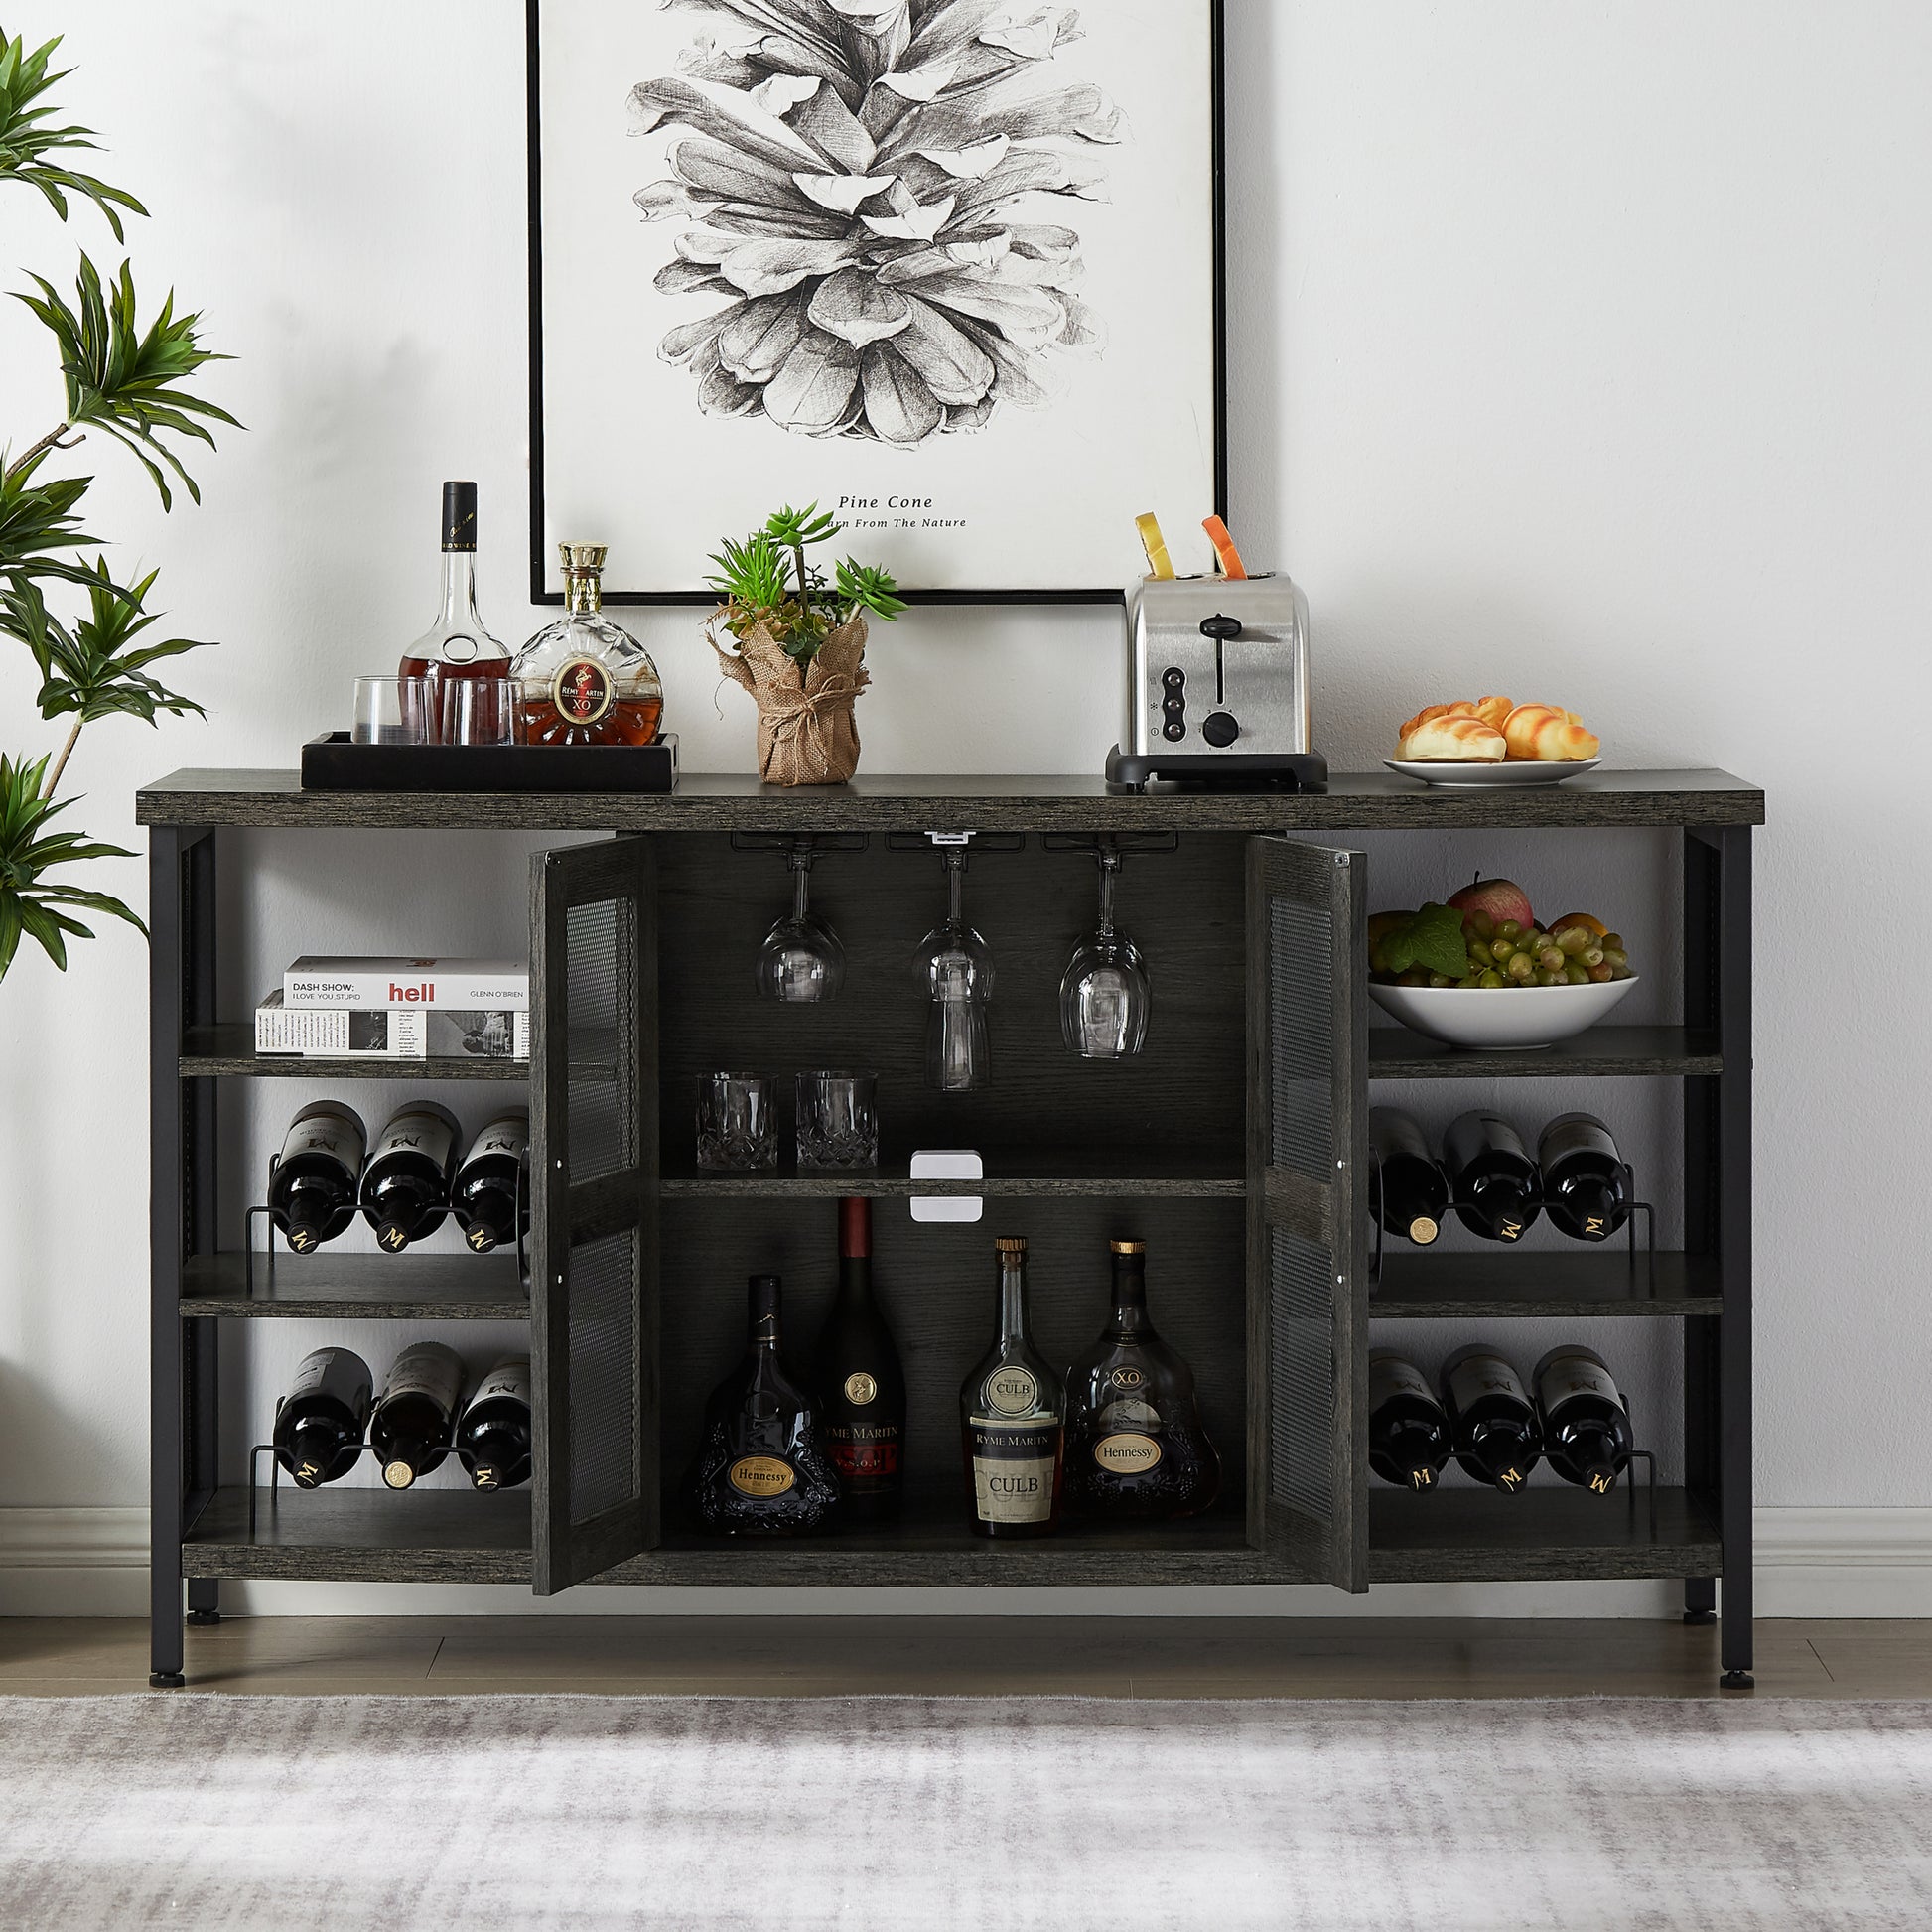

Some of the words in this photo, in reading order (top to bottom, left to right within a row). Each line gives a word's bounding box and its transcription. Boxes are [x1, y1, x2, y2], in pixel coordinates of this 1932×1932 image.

[838, 495, 879, 509] Pine
[887, 495, 933, 509] Cone
[855, 518, 888, 528] From
[894, 518, 916, 528] The
[921, 518, 966, 528] Nature
[572, 698, 591, 711] XO
[293, 983, 320, 992] DASH
[321, 983, 355, 992] SHOW:
[388, 983, 435, 1002] hell
[495, 990, 524, 999] O'BRIEN
[996, 1383, 1030, 1394] CULB
[976, 1433, 1006, 1446] RYME
[1008, 1435, 1049, 1447] MARITN
[1103, 1447, 1153, 1459] Hennessy
[739, 1468, 787, 1485] Hennessy
[1411, 1468, 1431, 1491] M
[989, 1477, 1038, 1492] CULB
